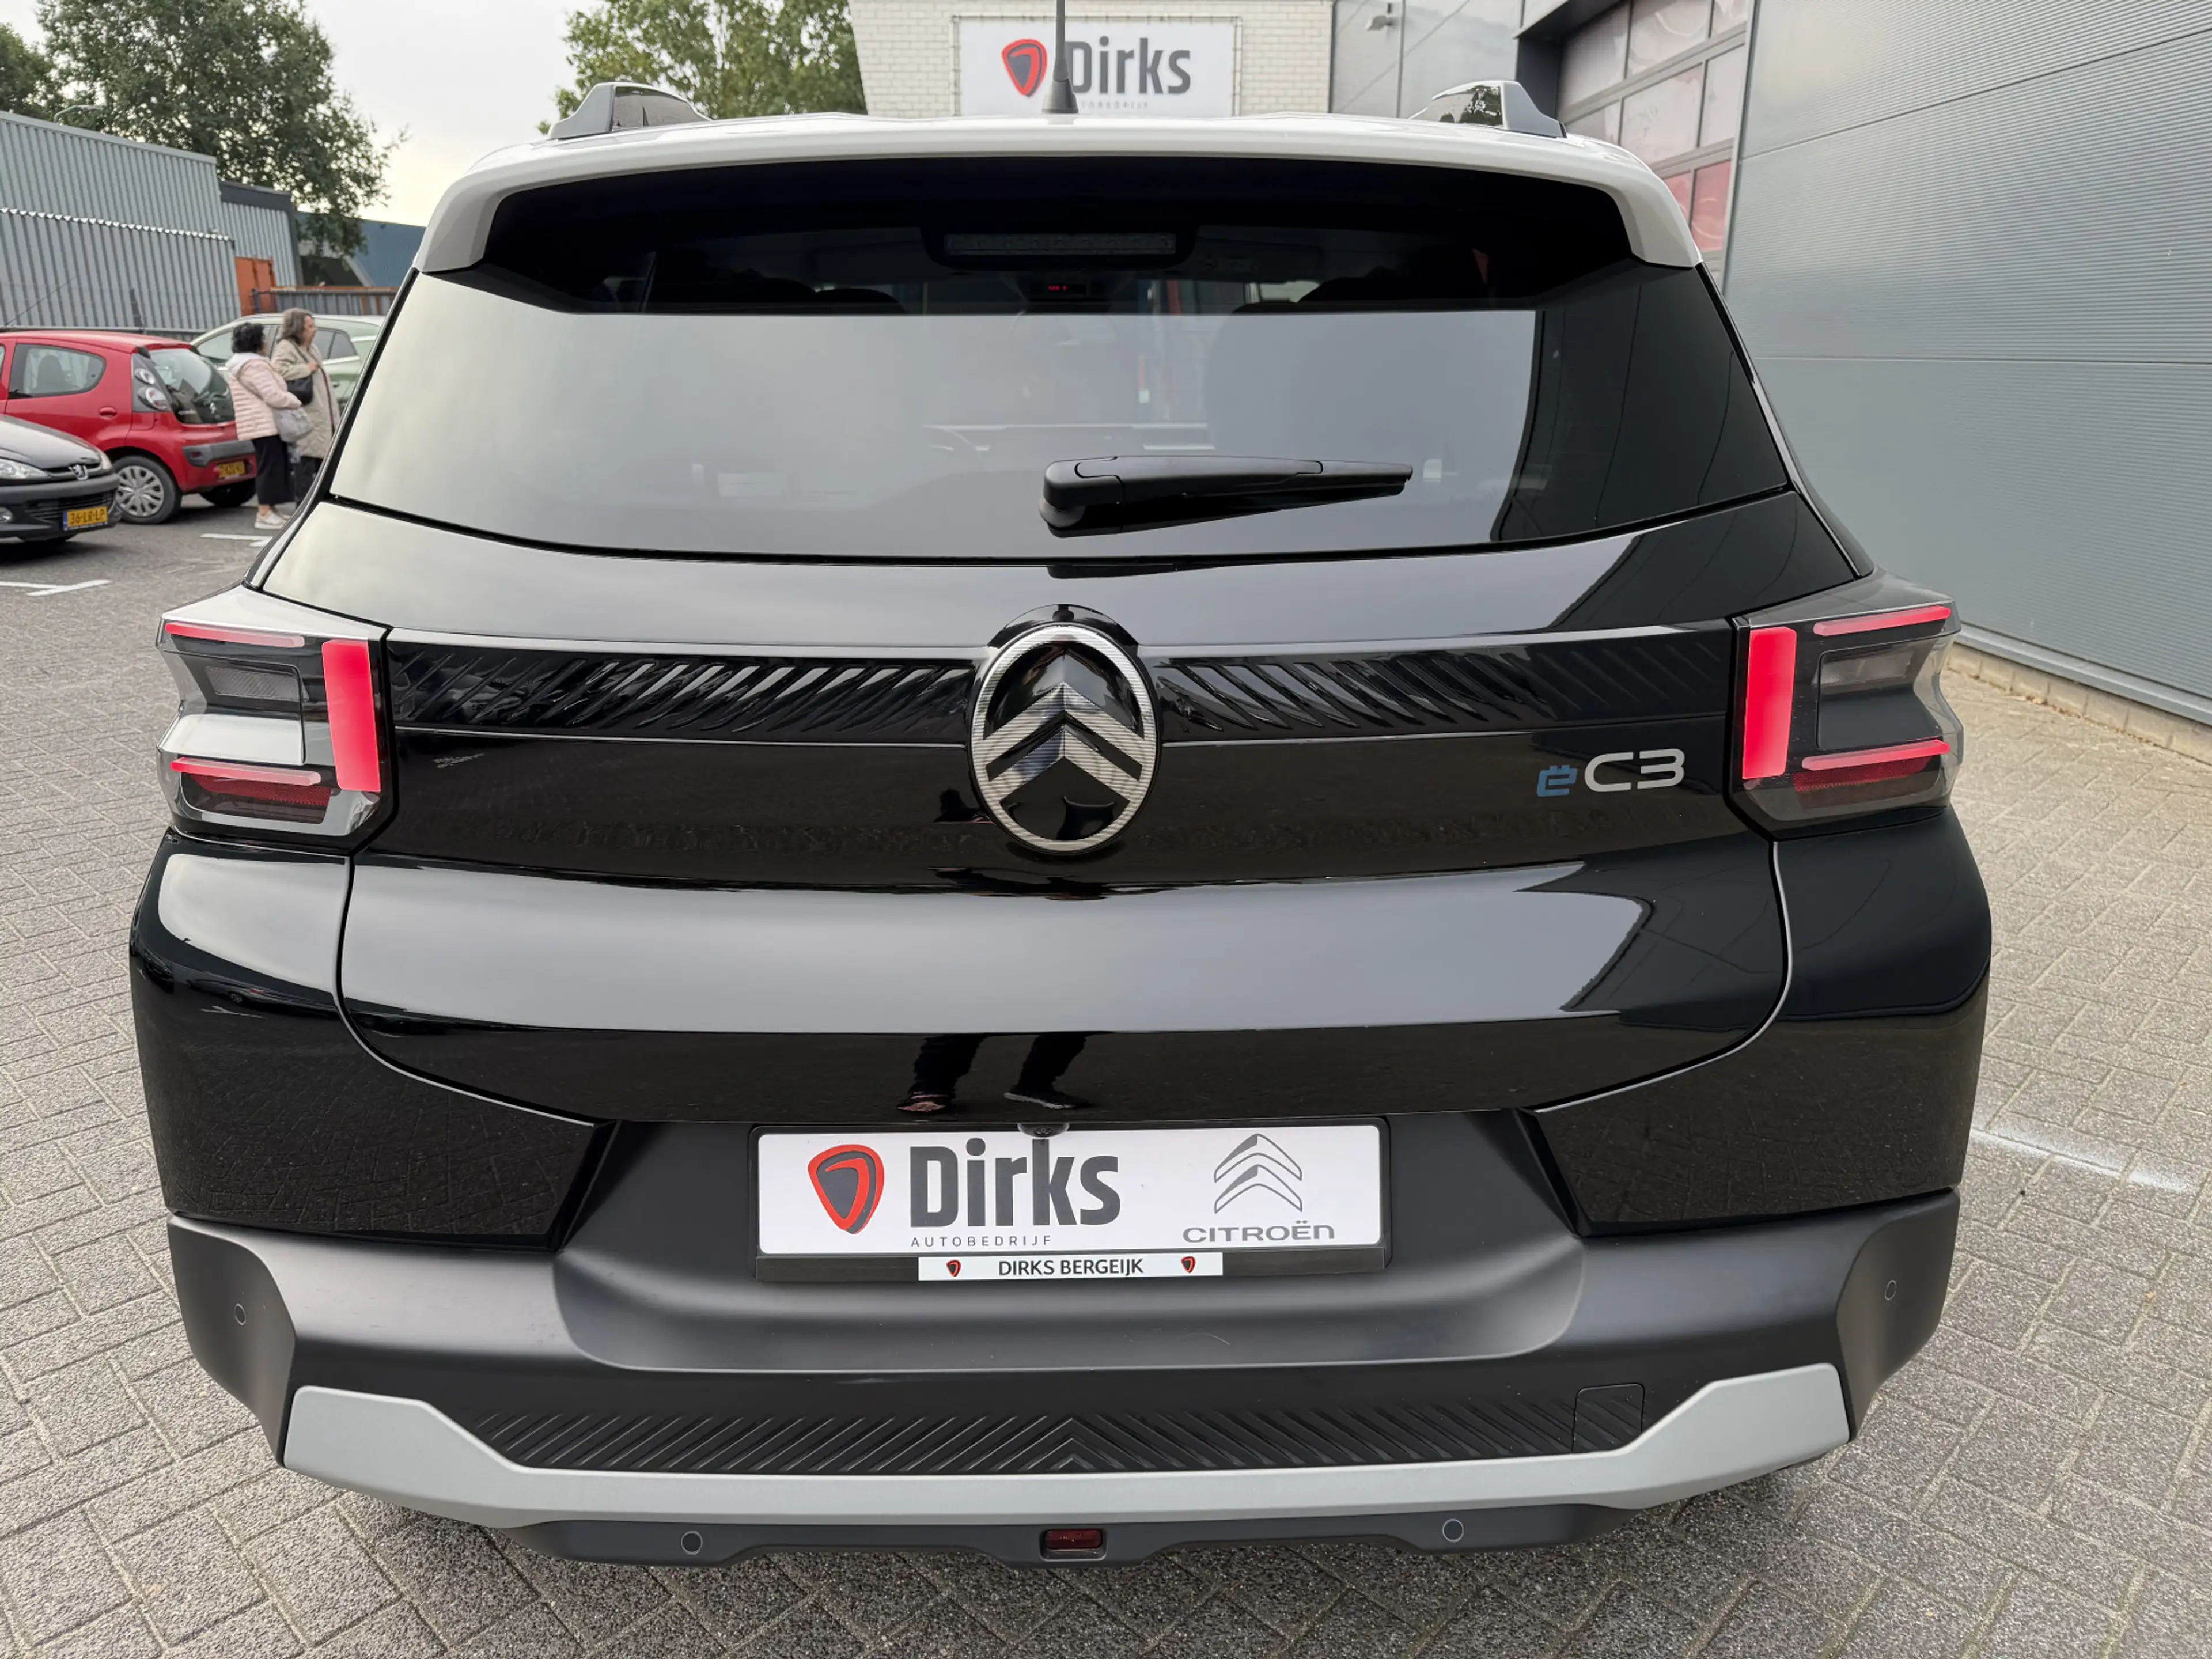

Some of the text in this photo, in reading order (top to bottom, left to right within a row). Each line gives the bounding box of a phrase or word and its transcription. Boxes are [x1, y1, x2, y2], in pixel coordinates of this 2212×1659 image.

[1065, 36, 1191, 94] Dirks
[910, 1137, 1120, 1227] Dirks
[911, 1235, 1051, 1247] AUTOBEDRIJF
[999, 1258, 1143, 1276] DIRKS BERGEIJK
